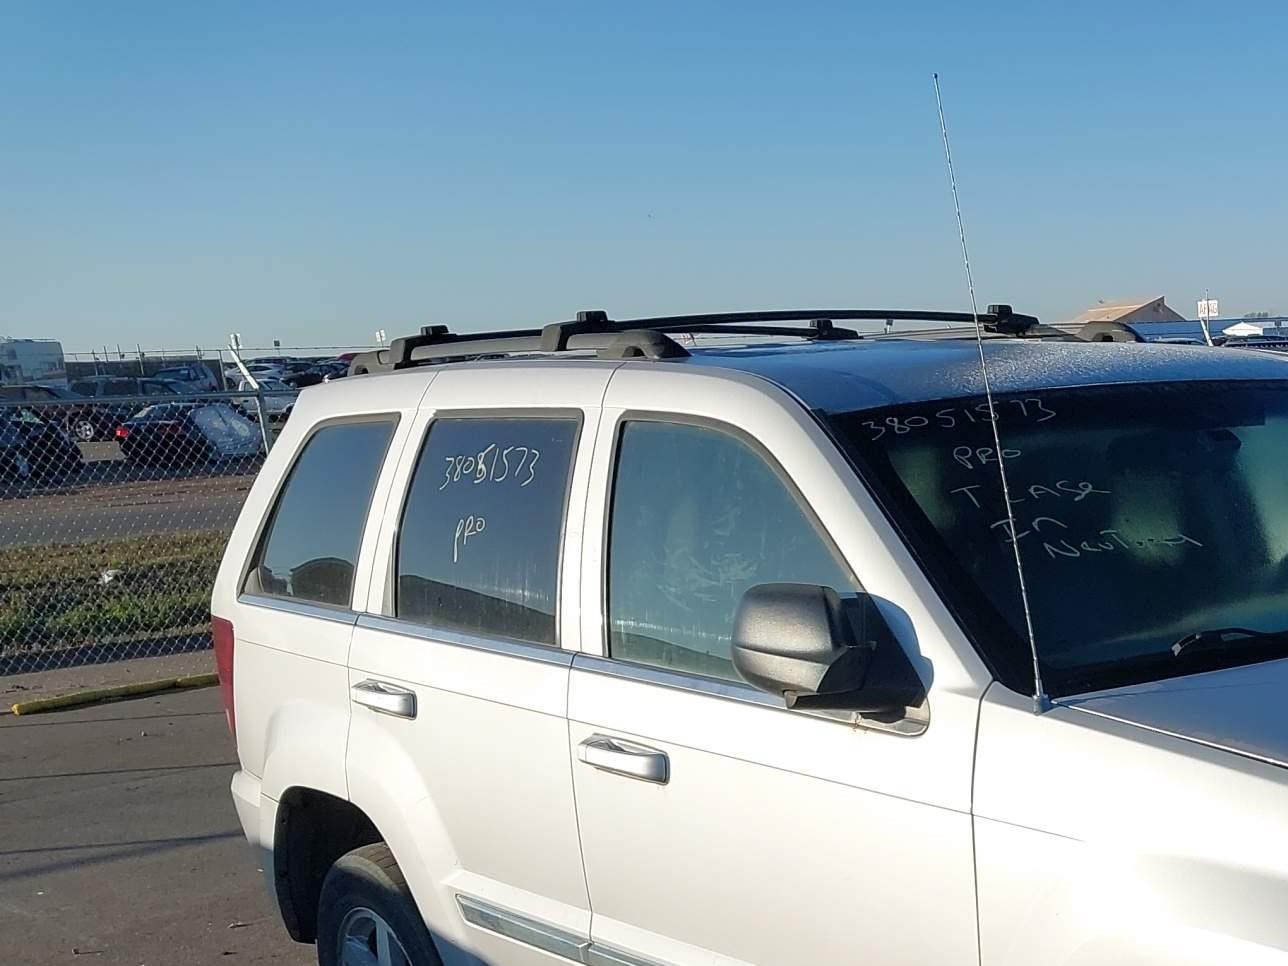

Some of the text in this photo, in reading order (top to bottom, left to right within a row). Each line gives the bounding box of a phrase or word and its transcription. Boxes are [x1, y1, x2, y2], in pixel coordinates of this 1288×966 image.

[862, 398, 1057, 441] 38051573
[953, 446, 1022, 470] PRO
[453, 515, 486, 562] PRO
